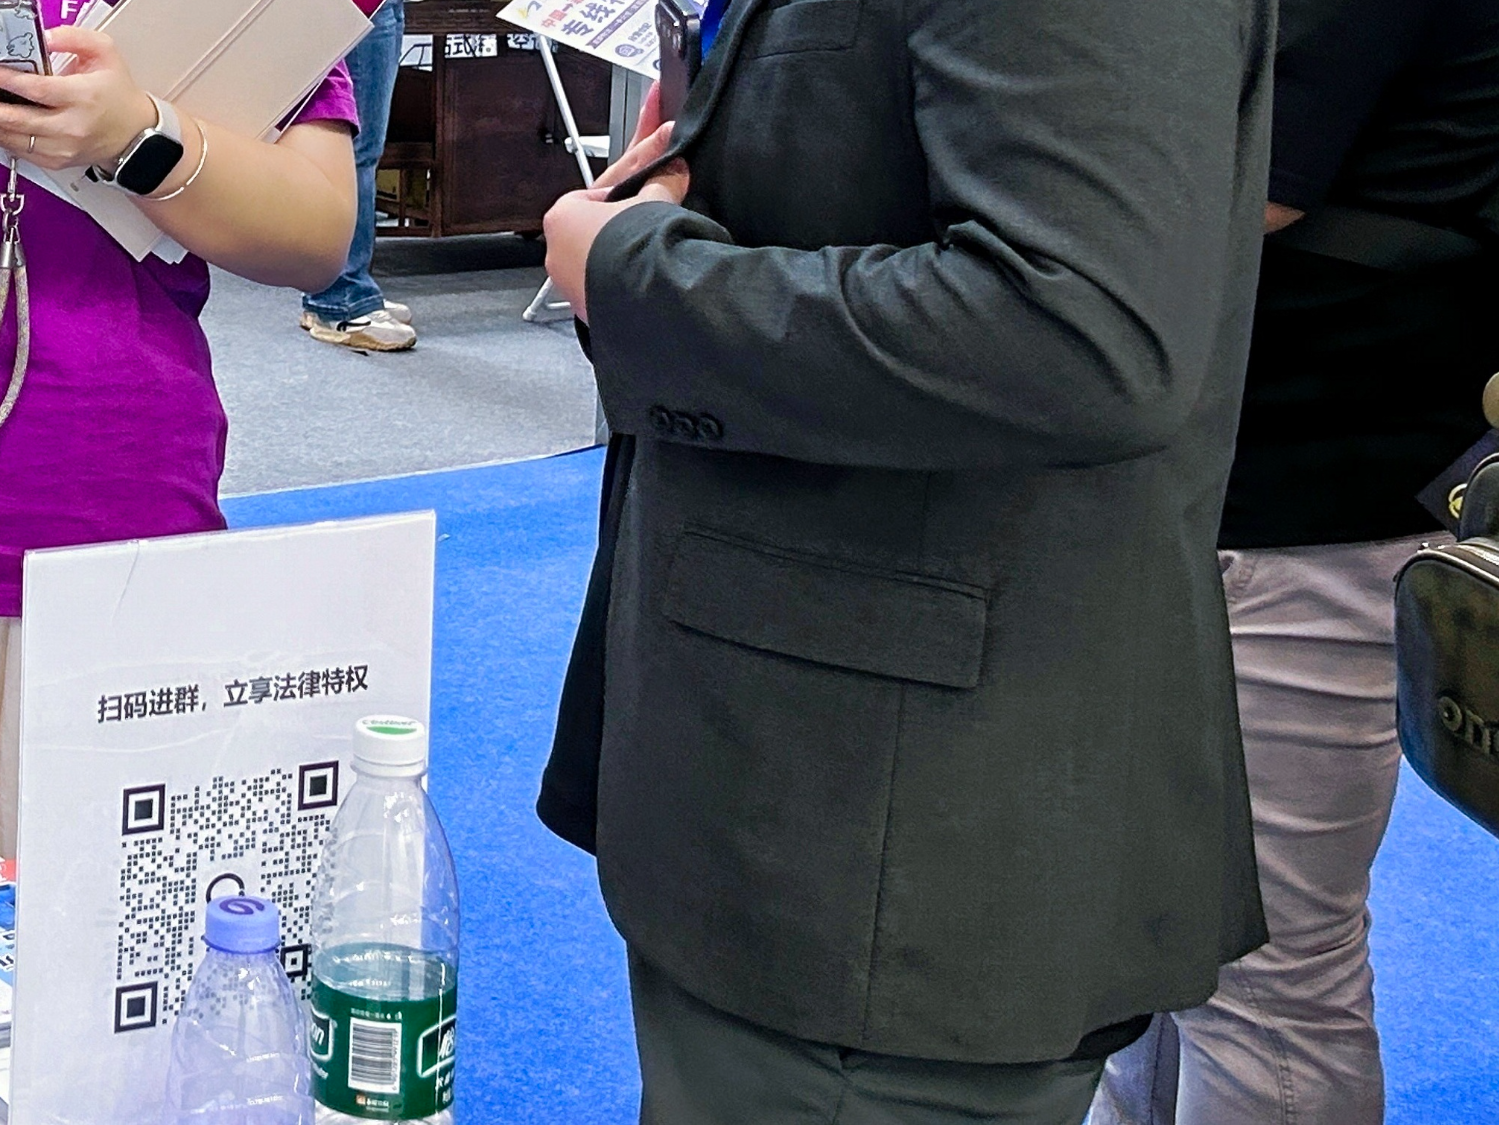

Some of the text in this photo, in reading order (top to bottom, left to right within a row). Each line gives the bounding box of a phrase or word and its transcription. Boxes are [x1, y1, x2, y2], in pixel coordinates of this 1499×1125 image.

[97, 664, 369, 724] 扫码进群，立享法律特权
